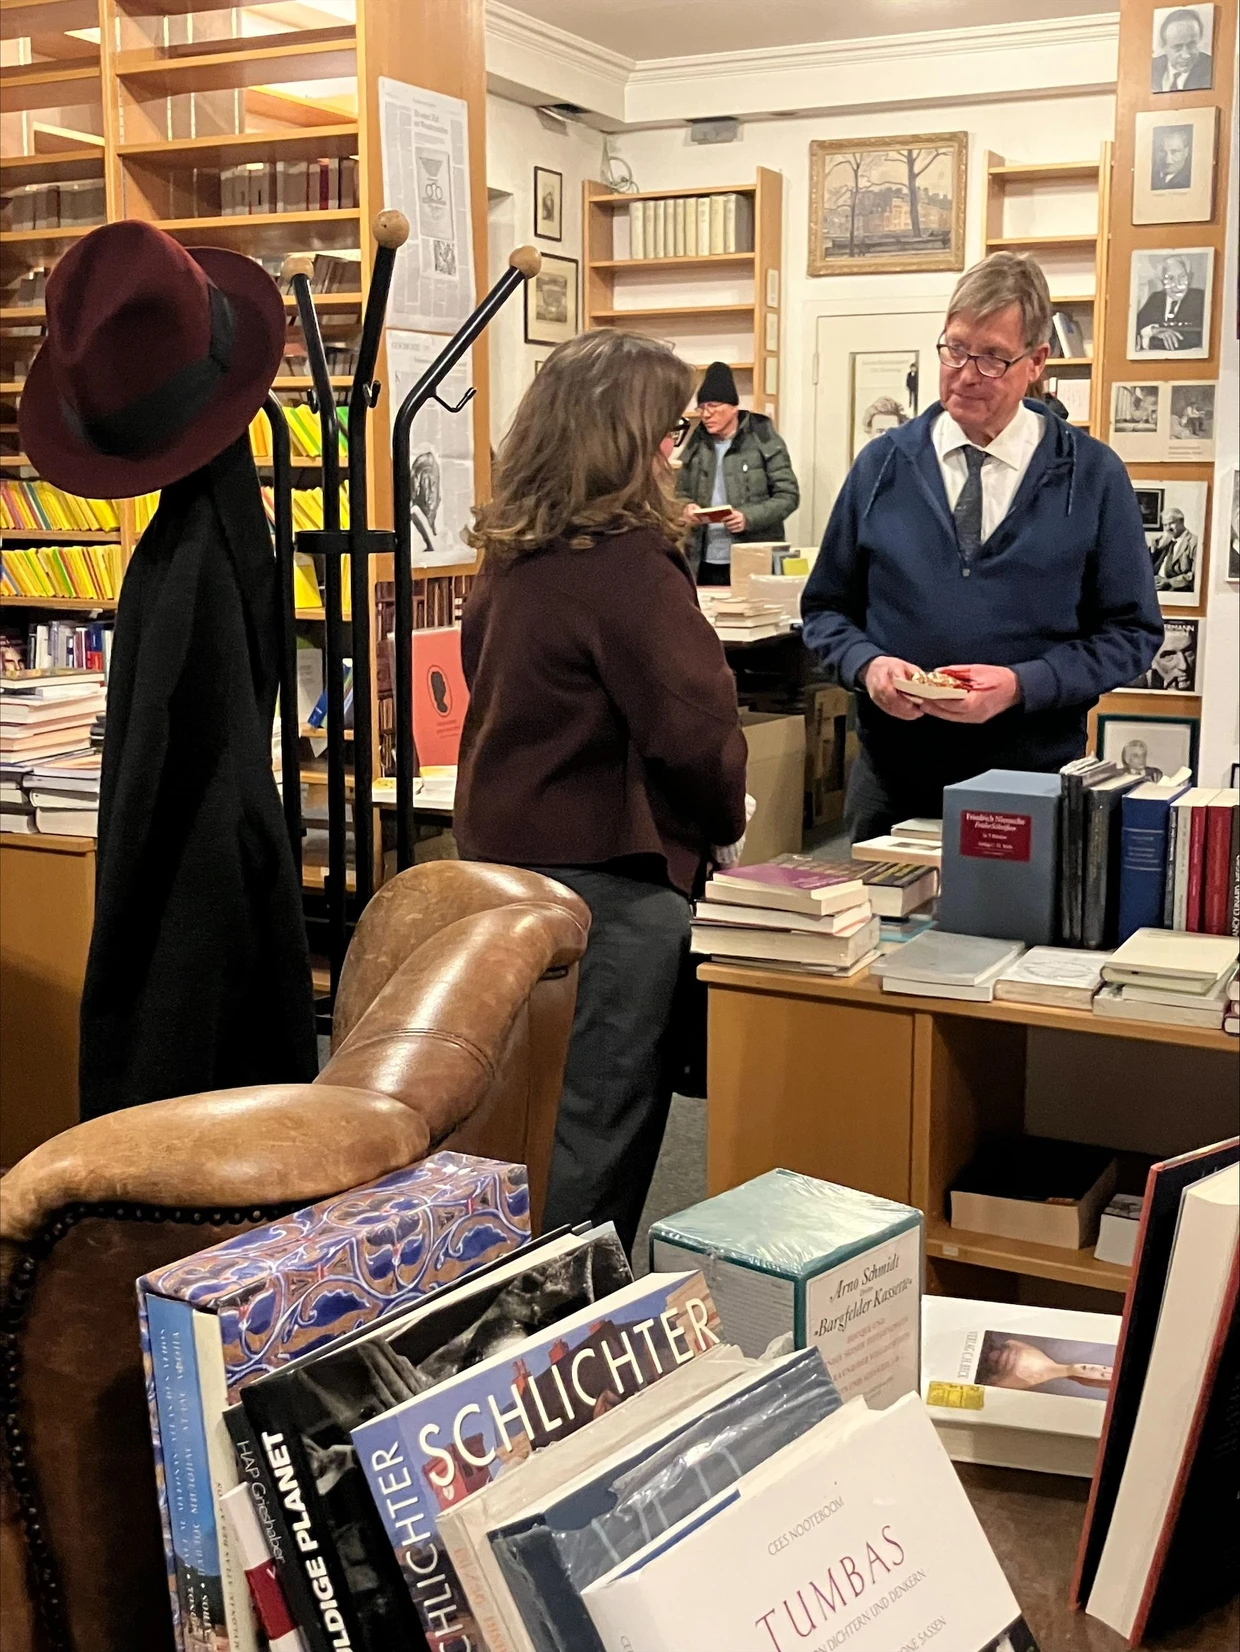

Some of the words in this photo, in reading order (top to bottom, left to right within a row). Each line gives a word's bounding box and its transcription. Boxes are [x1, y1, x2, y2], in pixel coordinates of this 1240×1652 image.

[829, 1279, 859, 1304] Arno
[861, 1253, 900, 1286] Schmidt
[418, 1297, 721, 1501] SCHLICHTER
[237, 1440, 260, 1479] HAP
[251, 1482, 286, 1565] Grieshaber
[261, 1431, 319, 1552] PLANET
[767, 1534, 790, 1556] CEES
[788, 1496, 845, 1542] NOOTEBOOM
[305, 1556, 354, 1652] LDIGE
[755, 1525, 905, 1652] TUMBAS
[827, 1611, 872, 1652] DICHTERN
[869, 1596, 890, 1619] UND
[889, 1568, 929, 1604] DENKERN
[918, 1615, 947, 1646] SASSEN
